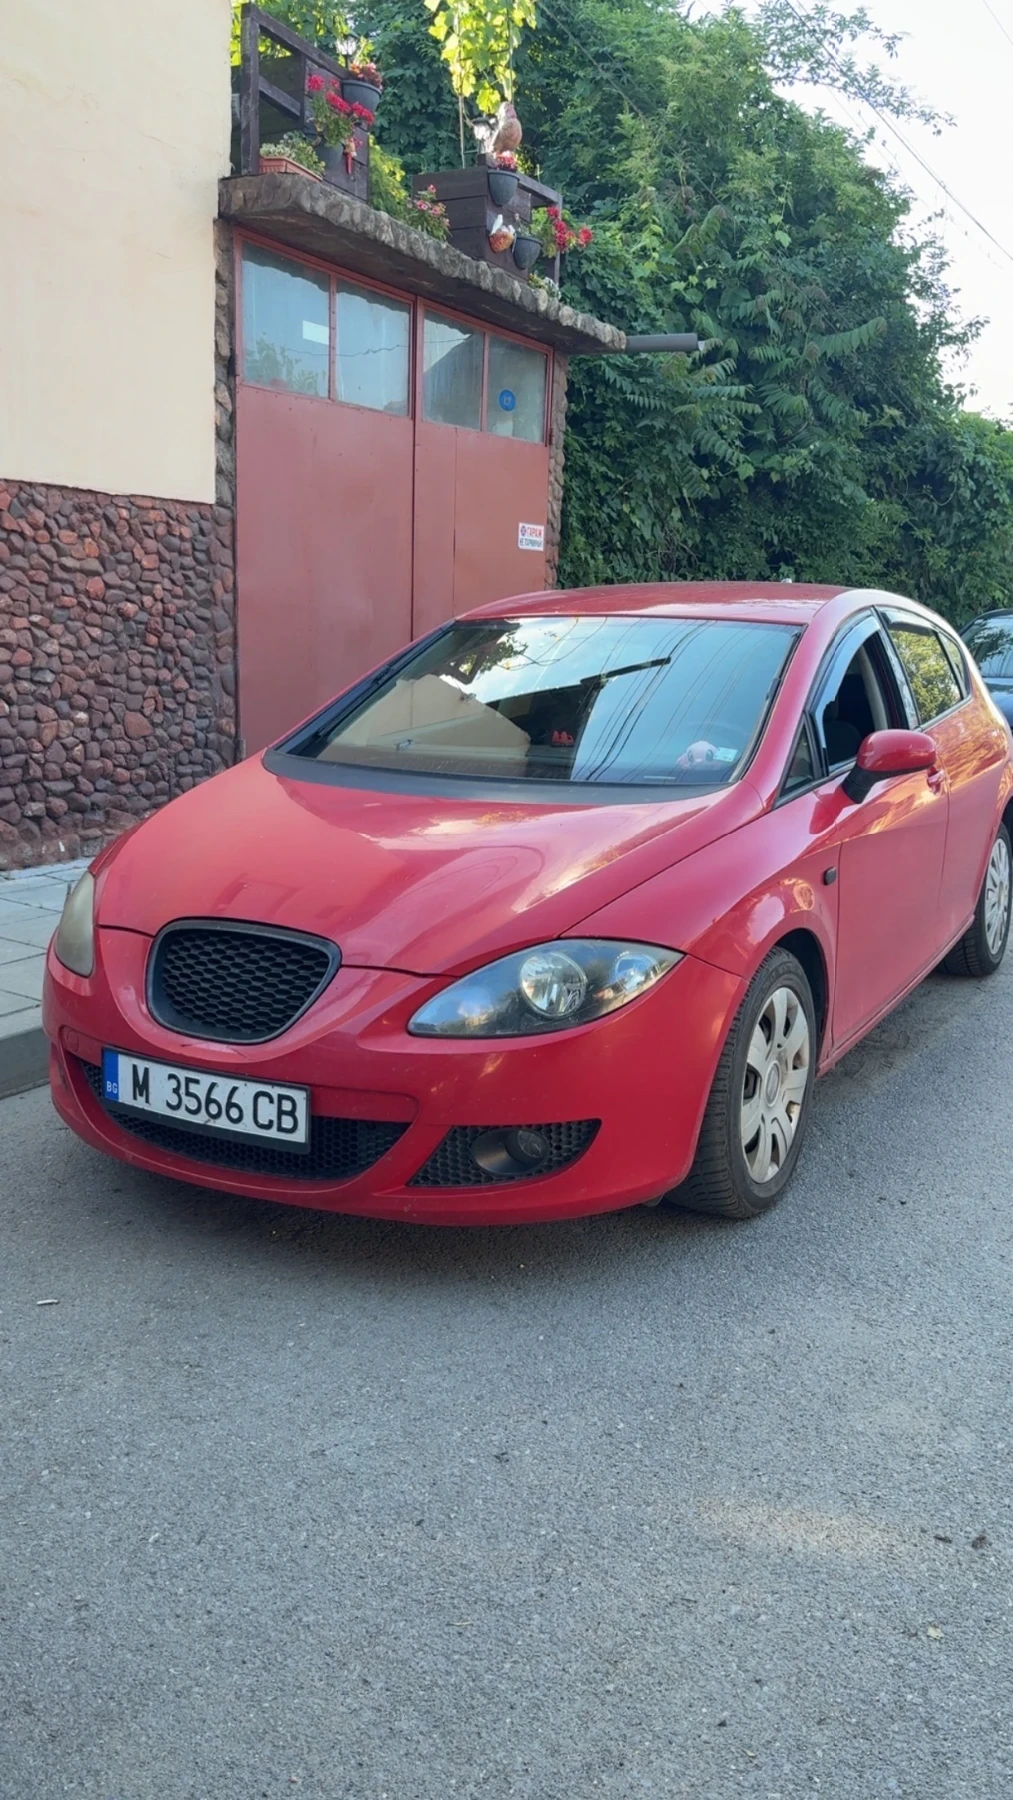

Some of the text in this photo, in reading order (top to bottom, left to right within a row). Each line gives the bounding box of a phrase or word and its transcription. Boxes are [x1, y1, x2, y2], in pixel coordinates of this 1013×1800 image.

[106, 1080, 118, 1094] BG
[132, 1063, 299, 1134] M 3566 CB
